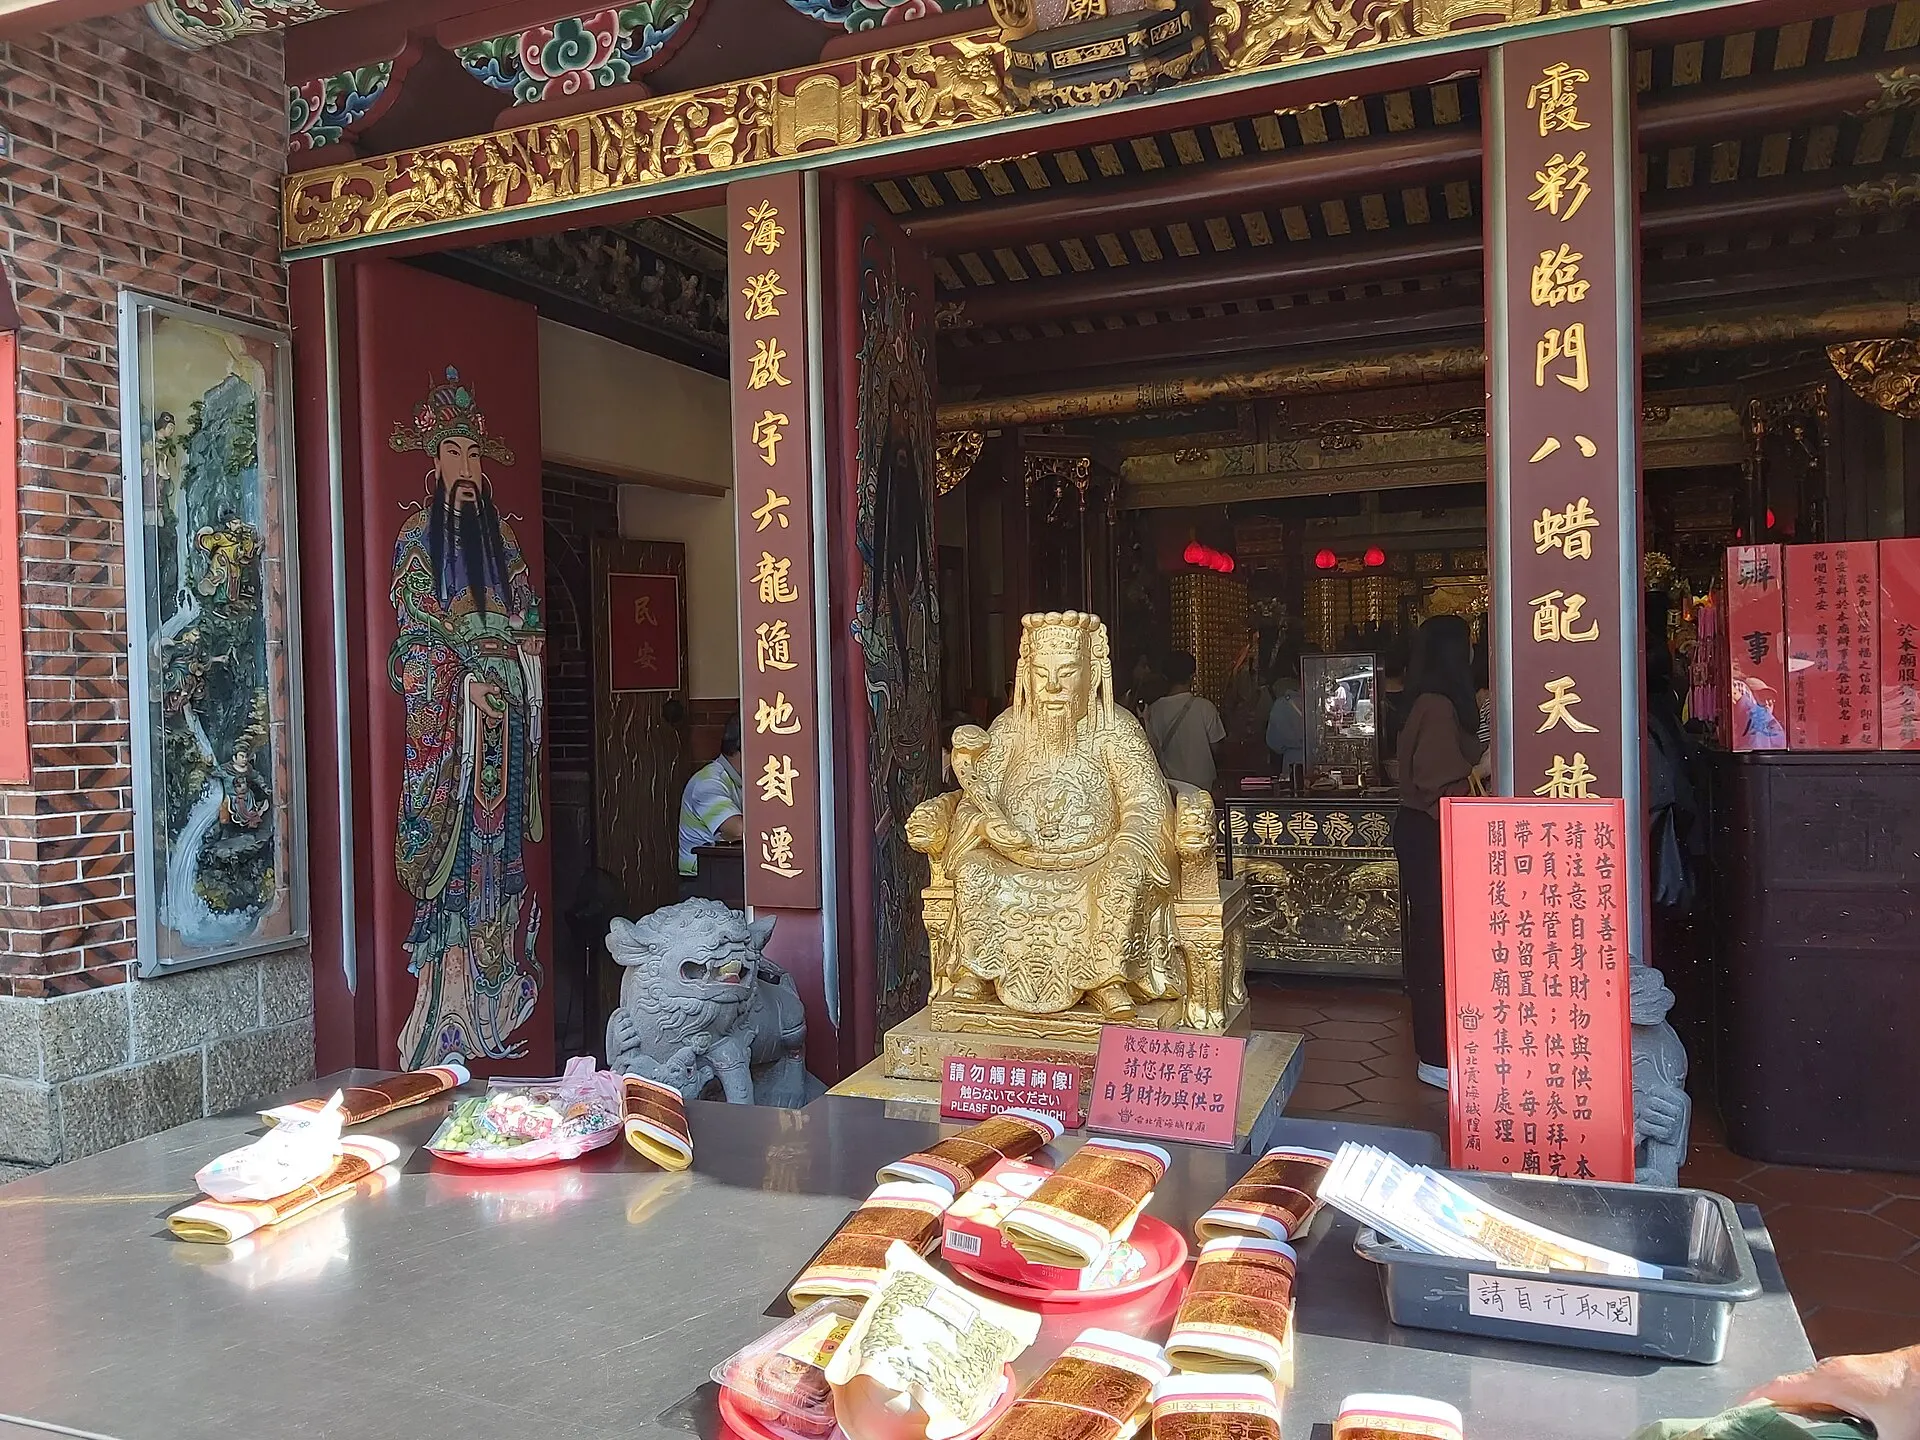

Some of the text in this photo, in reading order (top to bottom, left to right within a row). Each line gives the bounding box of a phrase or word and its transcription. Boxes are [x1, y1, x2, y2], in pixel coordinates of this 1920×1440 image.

[634, 596, 658, 671] 民安
[1487, 819, 1516, 1164] 關閉後將由廟方集中處理。
[1513, 820, 1541, 1176] 帶回，若留置供桌，每日廟
[1539, 822, 1568, 1178] 不負保管責任；供品參拜完
[1564, 820, 1595, 1179] 請注意自身財物與供品，本
[951, 1101, 988, 1113] PLEASE
[990, 1104, 1005, 1115] DO
[960, 1085, 1060, 1105] 触らないでください
[1104, 1081, 1225, 1113] 自身財物與供品
[1123, 1057, 1212, 1085] 請您保管好
[1464, 1041, 1481, 1151] 台北霞海城隍廟
[1477, 1280, 1632, 1326] 請自行取閱
